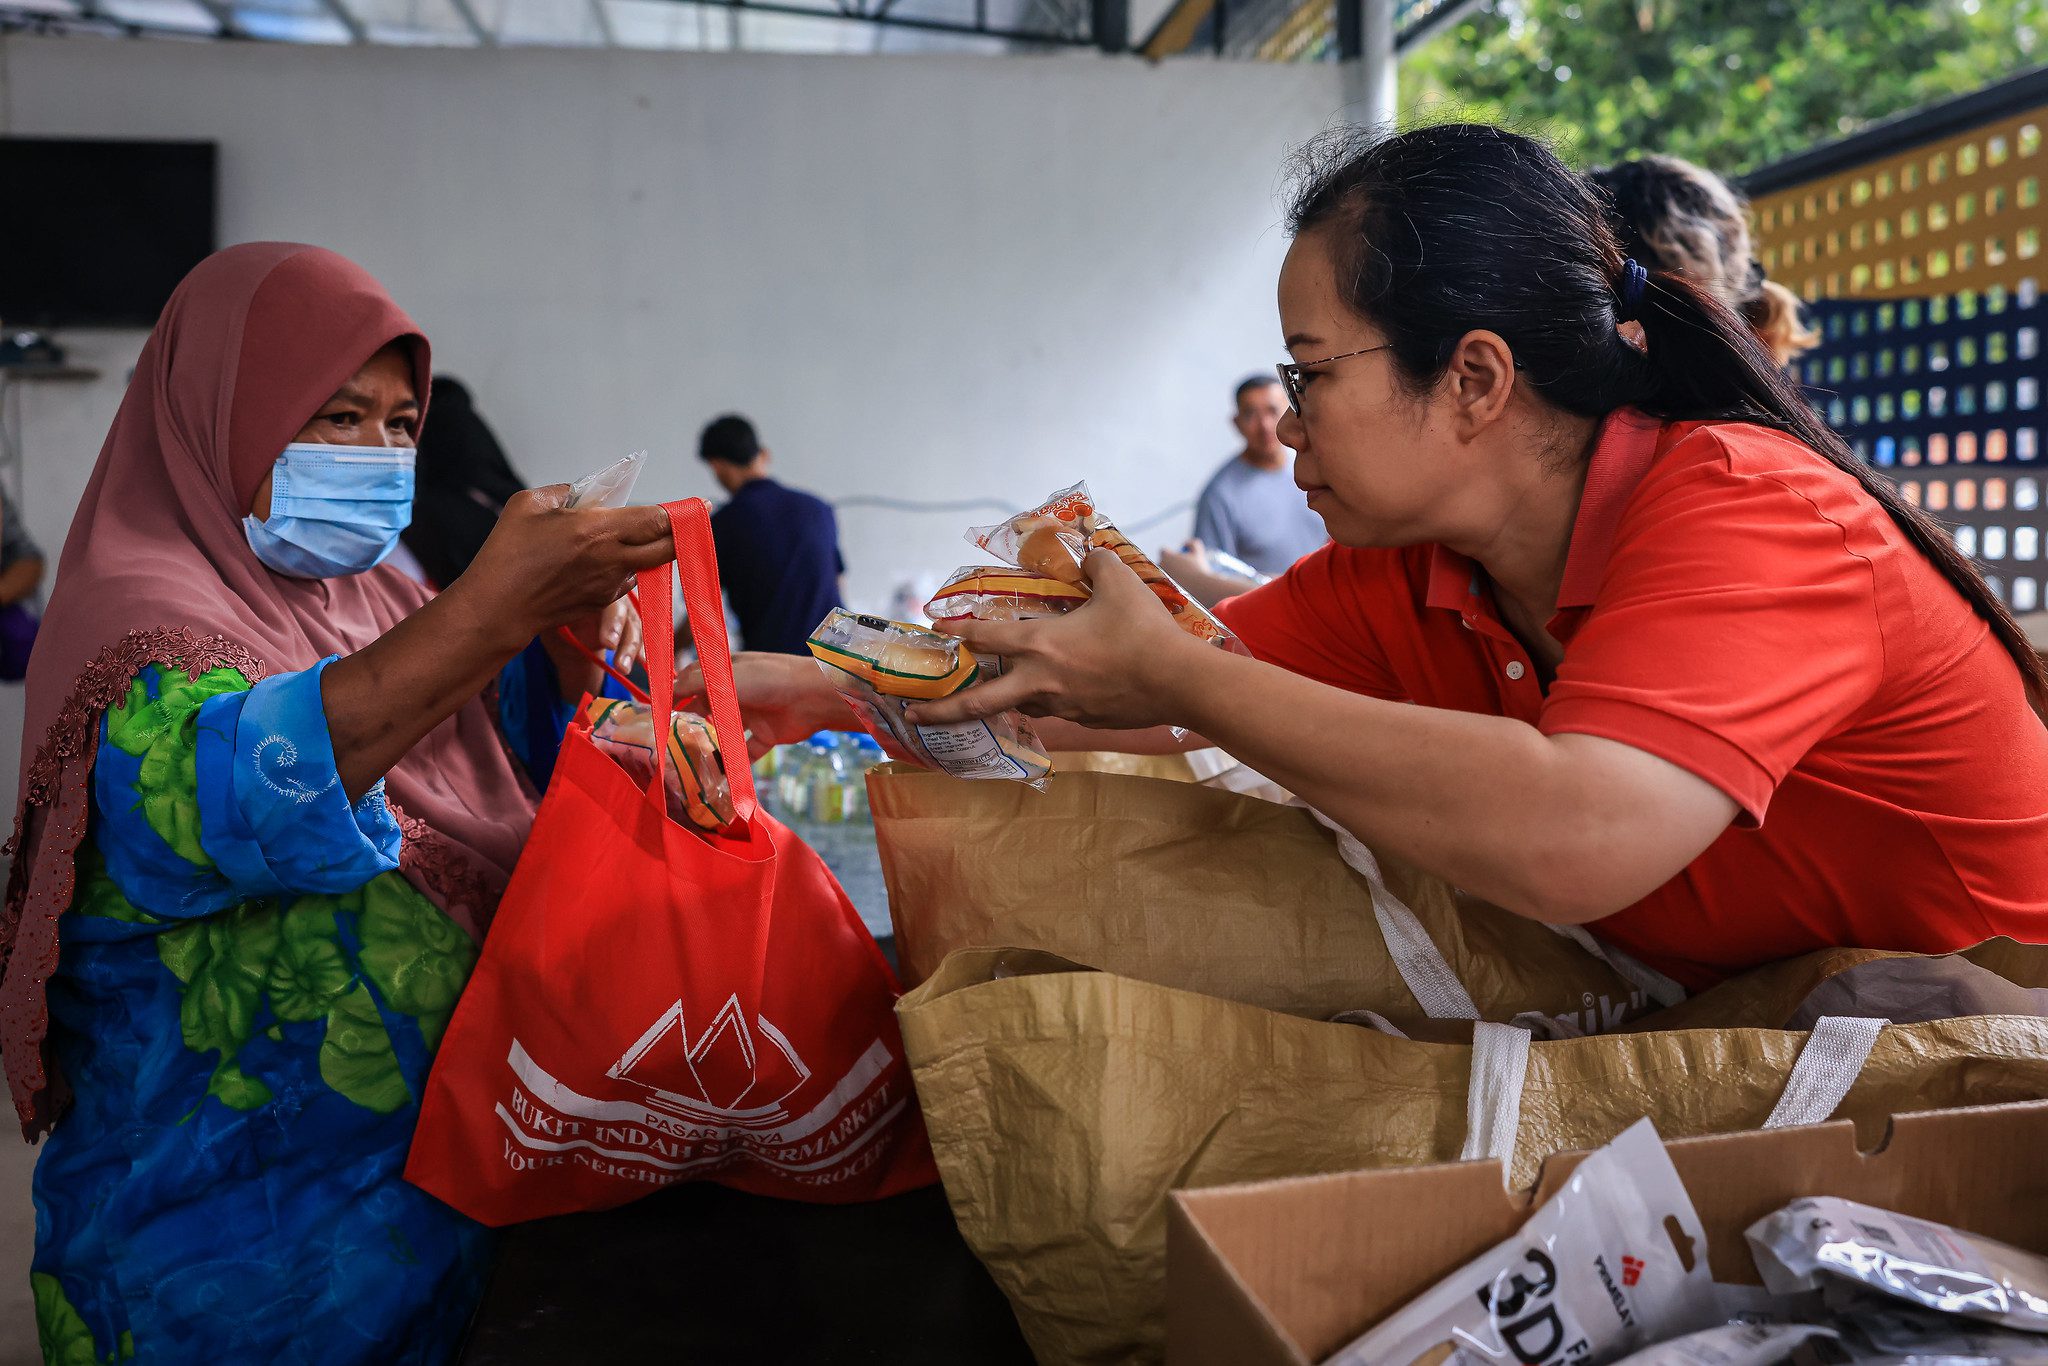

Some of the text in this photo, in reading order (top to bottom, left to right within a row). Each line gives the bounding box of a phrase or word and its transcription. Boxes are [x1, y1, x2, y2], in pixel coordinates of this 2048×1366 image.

[510, 1086, 586, 1137] BUKIT
[595, 1126, 692, 1159] INDAH
[645, 1112, 784, 1144] PASAR RAYA
[503, 1138, 565, 1171] YOUR
[1477, 1248, 1565, 1364] 3D
